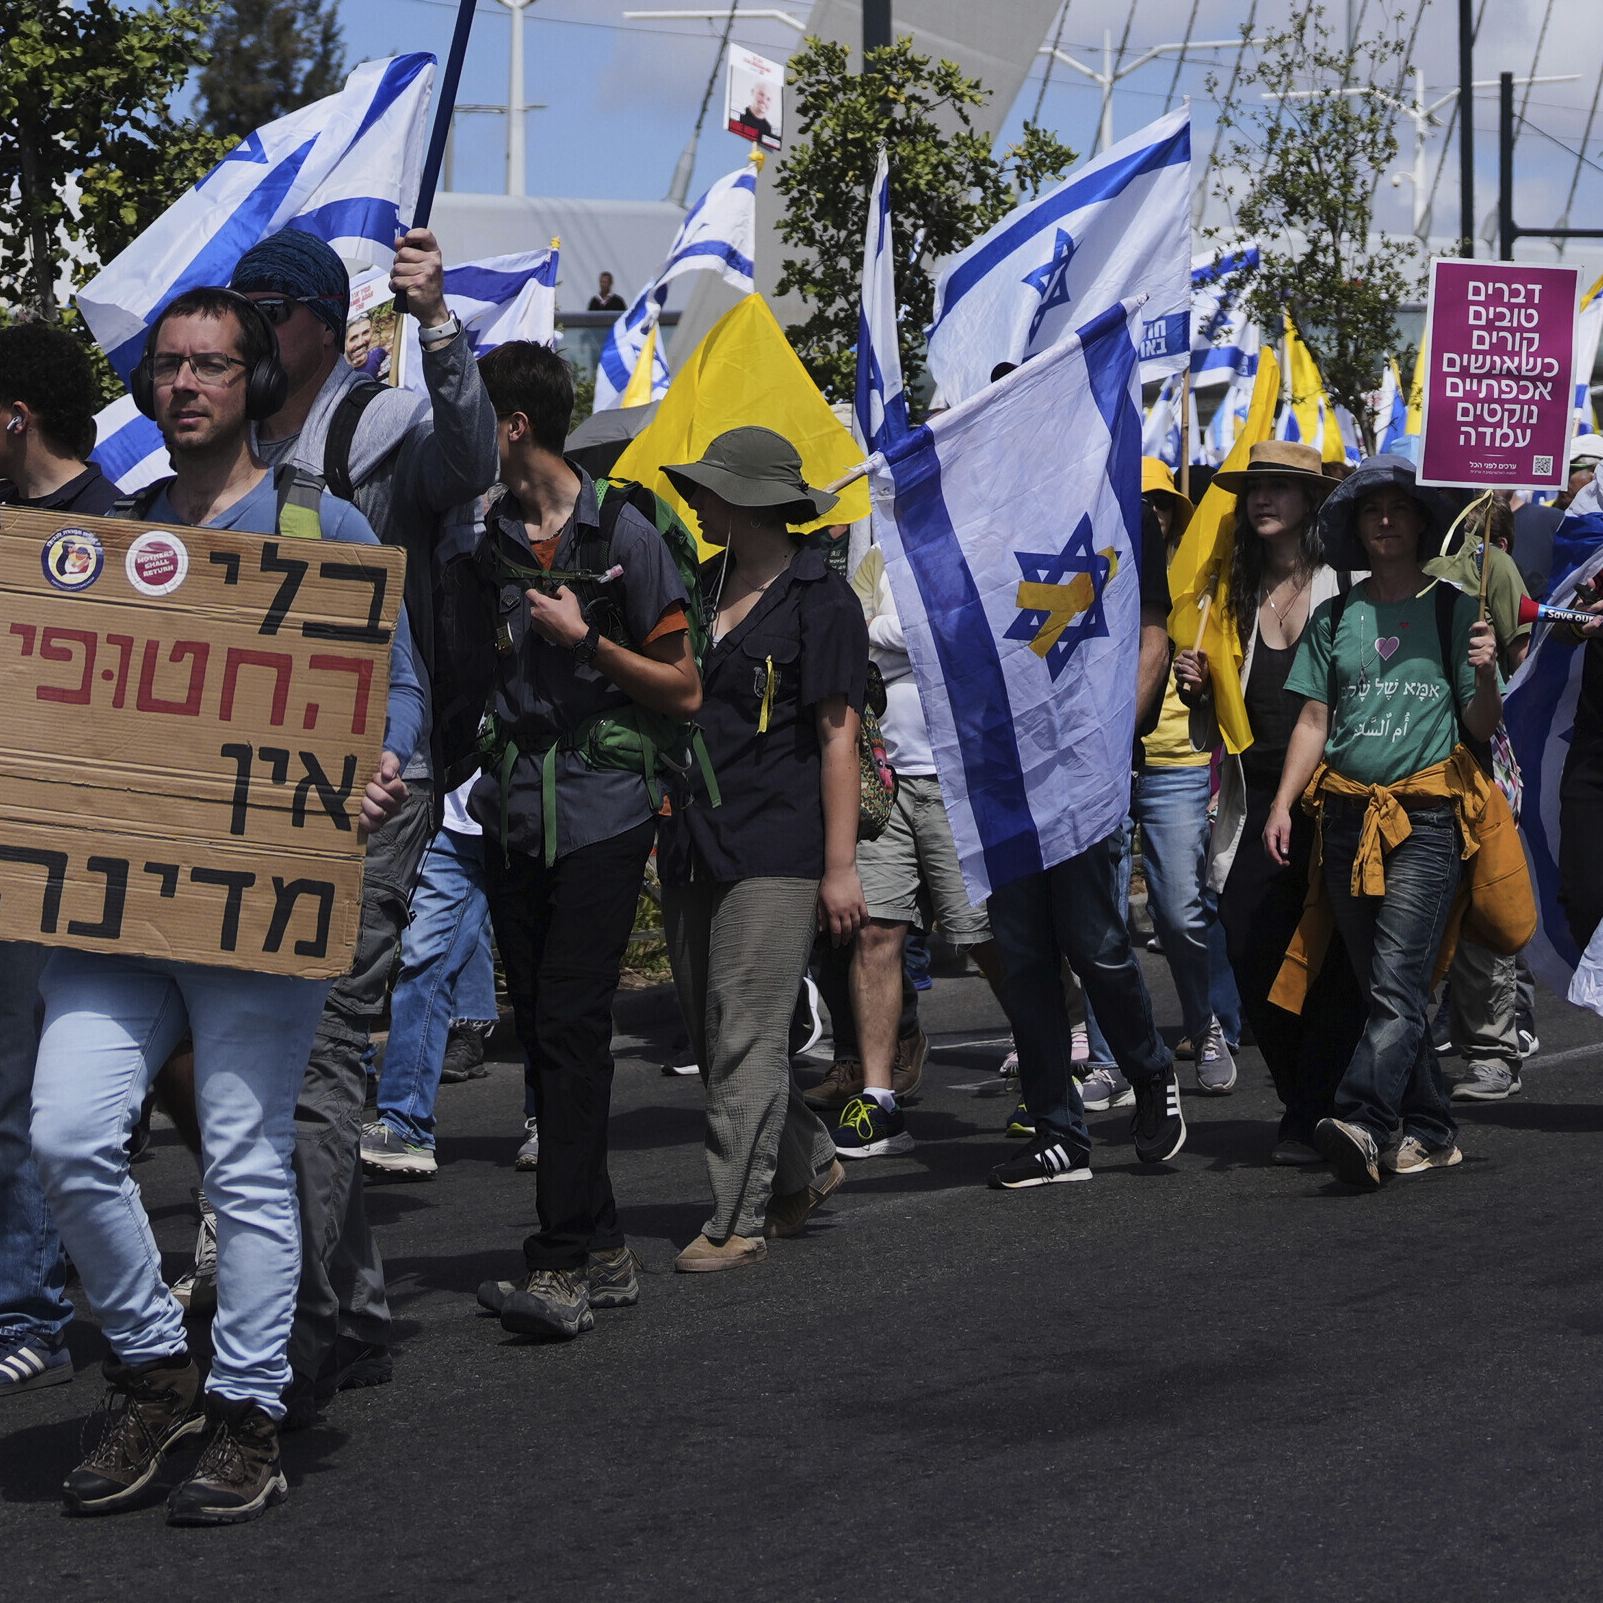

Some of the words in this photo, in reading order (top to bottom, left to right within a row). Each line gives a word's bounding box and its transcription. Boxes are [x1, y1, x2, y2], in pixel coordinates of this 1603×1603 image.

[1467, 281, 1543, 304] דברים
[1468, 305, 1539, 328] טובים
[1472, 330, 1540, 354] קורים
[1442, 352, 1559, 377] כשאנשים
[1446, 377, 1553, 401] אכפתיים
[1456, 402, 1539, 426] נוקטים
[1459, 426, 1531, 447] עמדה
[209, 542, 397, 645] בלי
[1547, 609, 1573, 621] Save
[220, 741, 358, 836] אין
